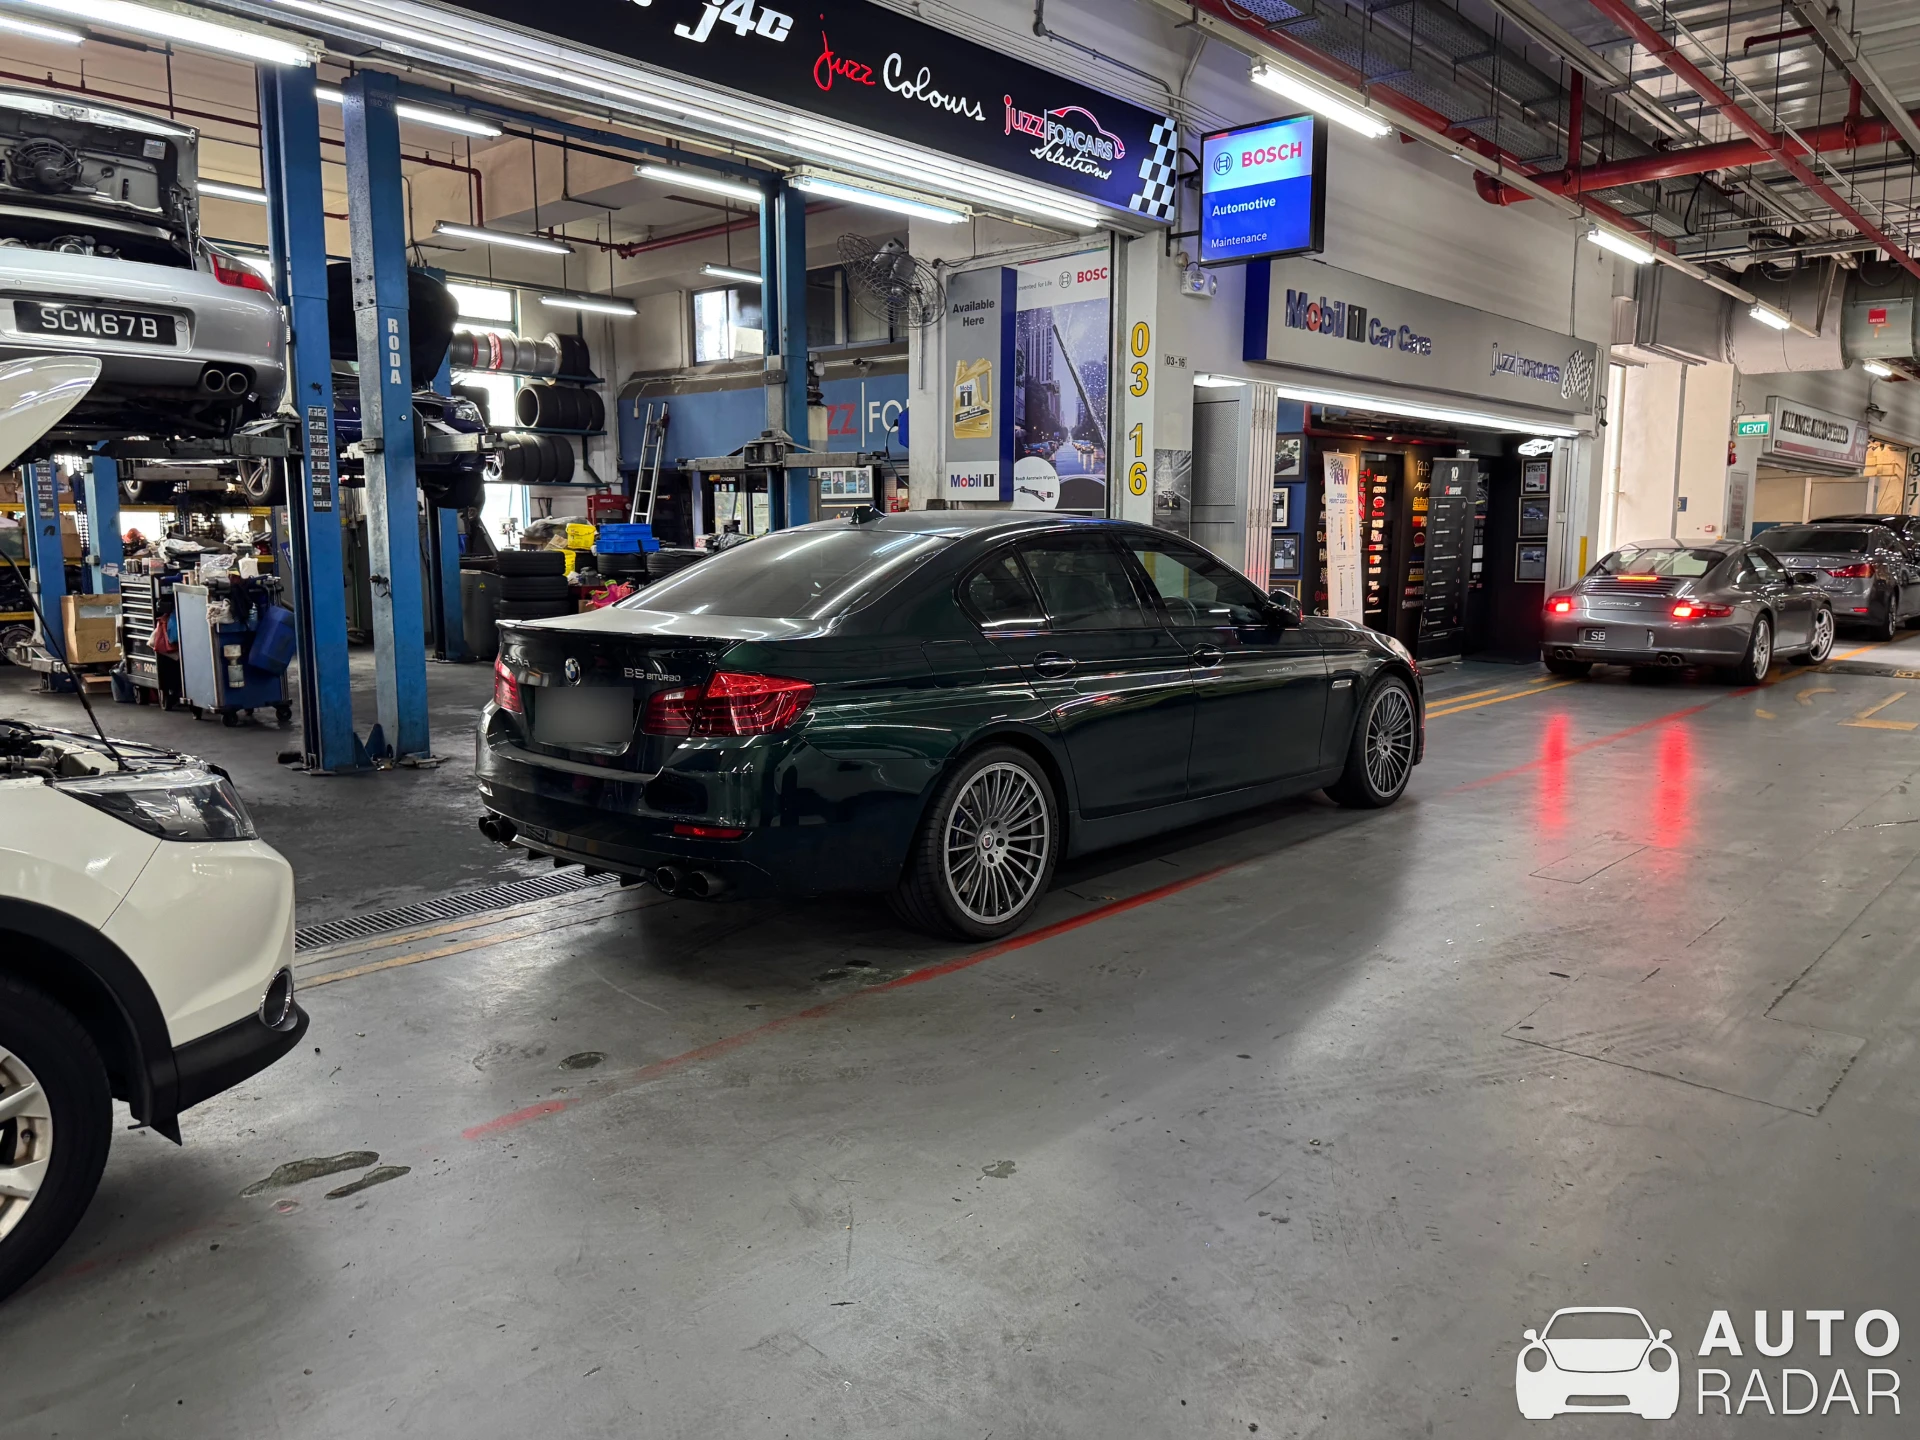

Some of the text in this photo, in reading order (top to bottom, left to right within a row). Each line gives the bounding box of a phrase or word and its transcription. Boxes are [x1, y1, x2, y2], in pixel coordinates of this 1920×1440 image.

[813, 13, 986, 121] juzz Colours
[1003, 94, 1113, 161] juzz FORCARS
[1029, 138, 1112, 180] Selections
[1241, 141, 1302, 168] BOSCH
[1211, 197, 1276, 217] Automotive
[1211, 232, 1267, 248] Maintenance
[952, 298, 995, 314] Available
[962, 315, 985, 327] Here
[1285, 288, 1346, 339] Mobil
[1369, 317, 1397, 349] Car
[1399, 324, 1432, 356] Care
[387, 318, 402, 385] RODA
[1166, 355, 1187, 368] 03-16
[1746, 423, 1765, 434] EXIT
[950, 473, 982, 488] Mobil
[623, 667, 681, 682] B5 BITURBO
